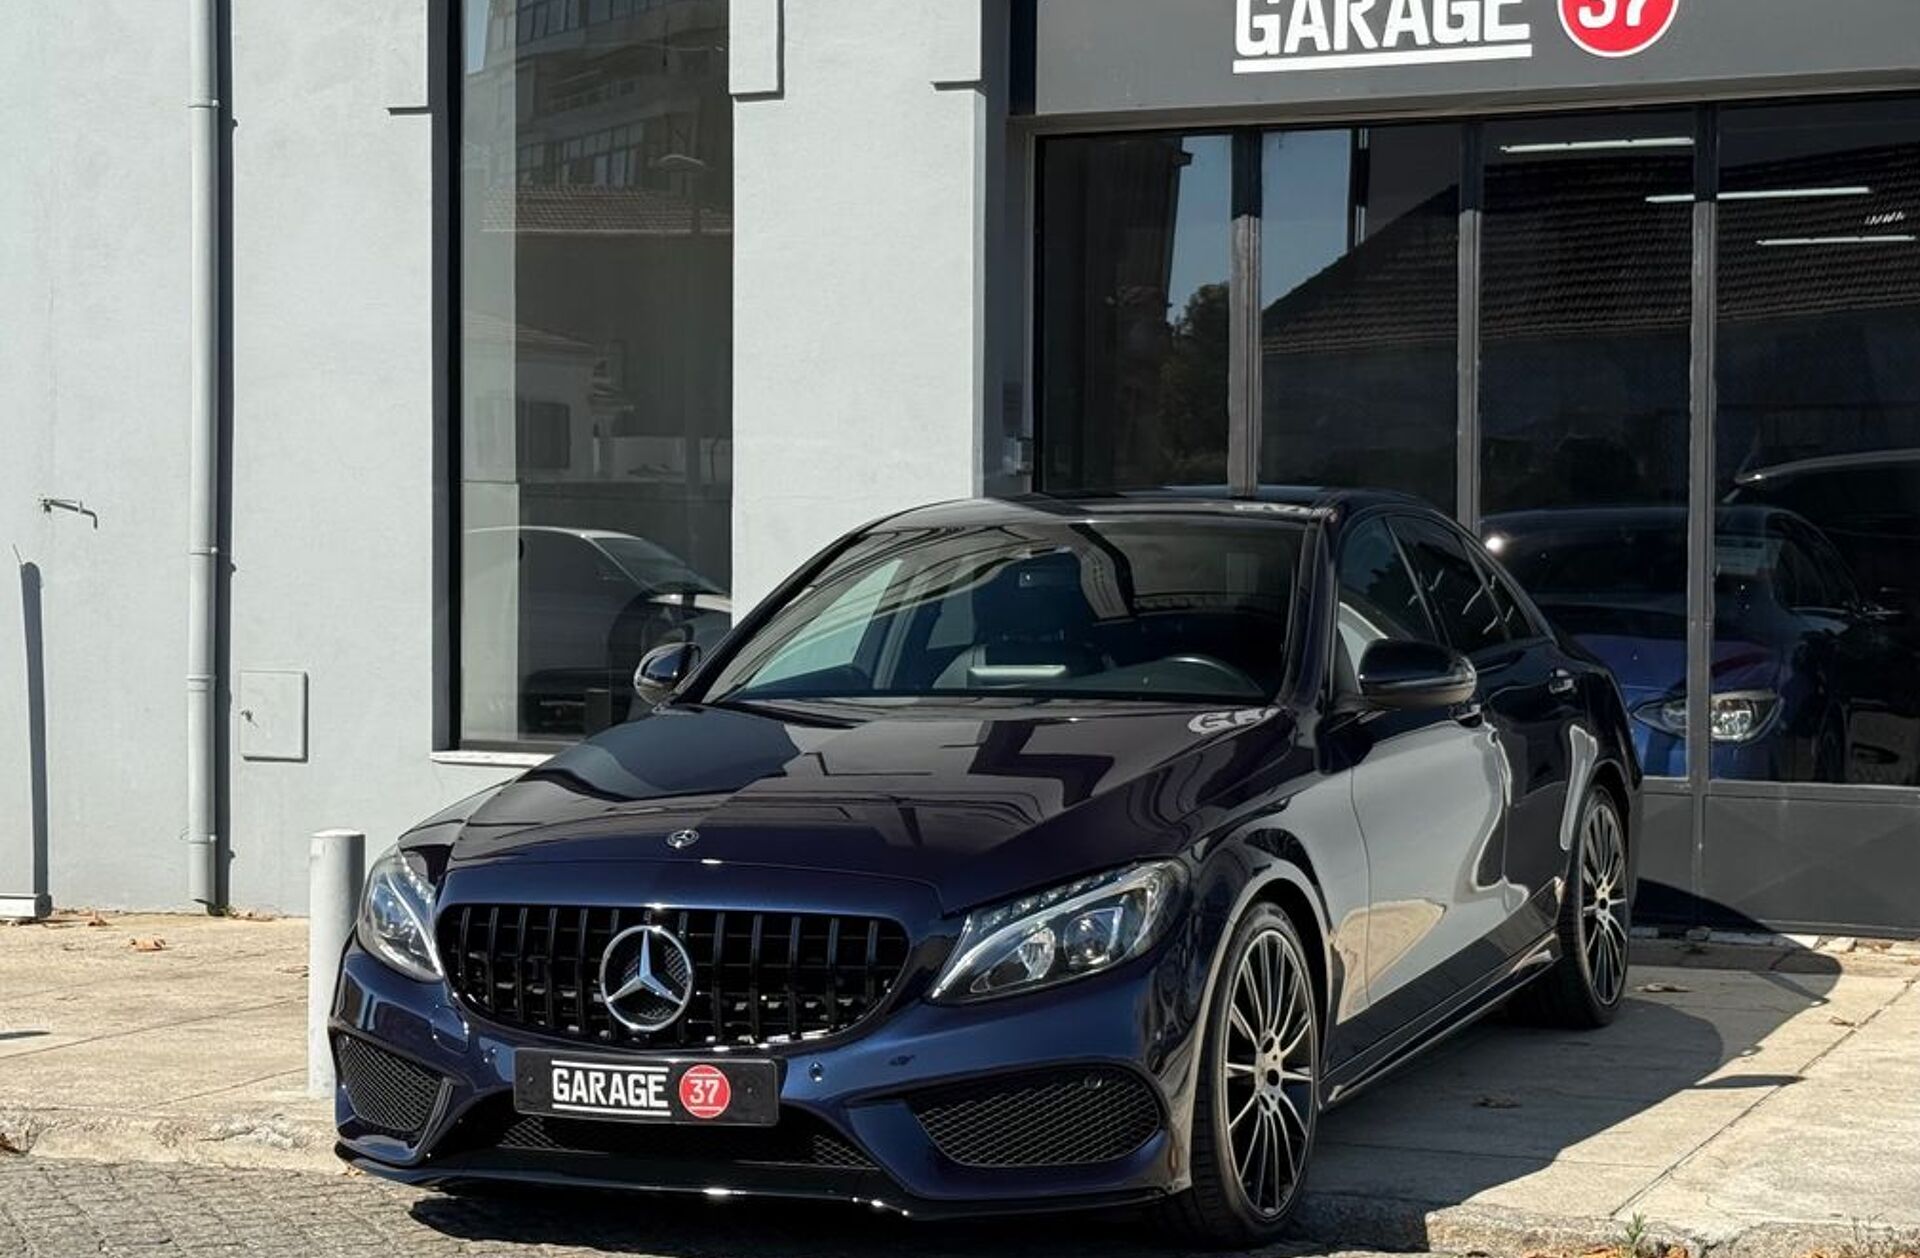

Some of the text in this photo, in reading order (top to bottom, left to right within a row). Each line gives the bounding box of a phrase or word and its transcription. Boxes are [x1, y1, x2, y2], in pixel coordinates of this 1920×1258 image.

[1235, 0, 1531, 56] GARAGE
[552, 1067, 720, 1108] GARAGE 37
